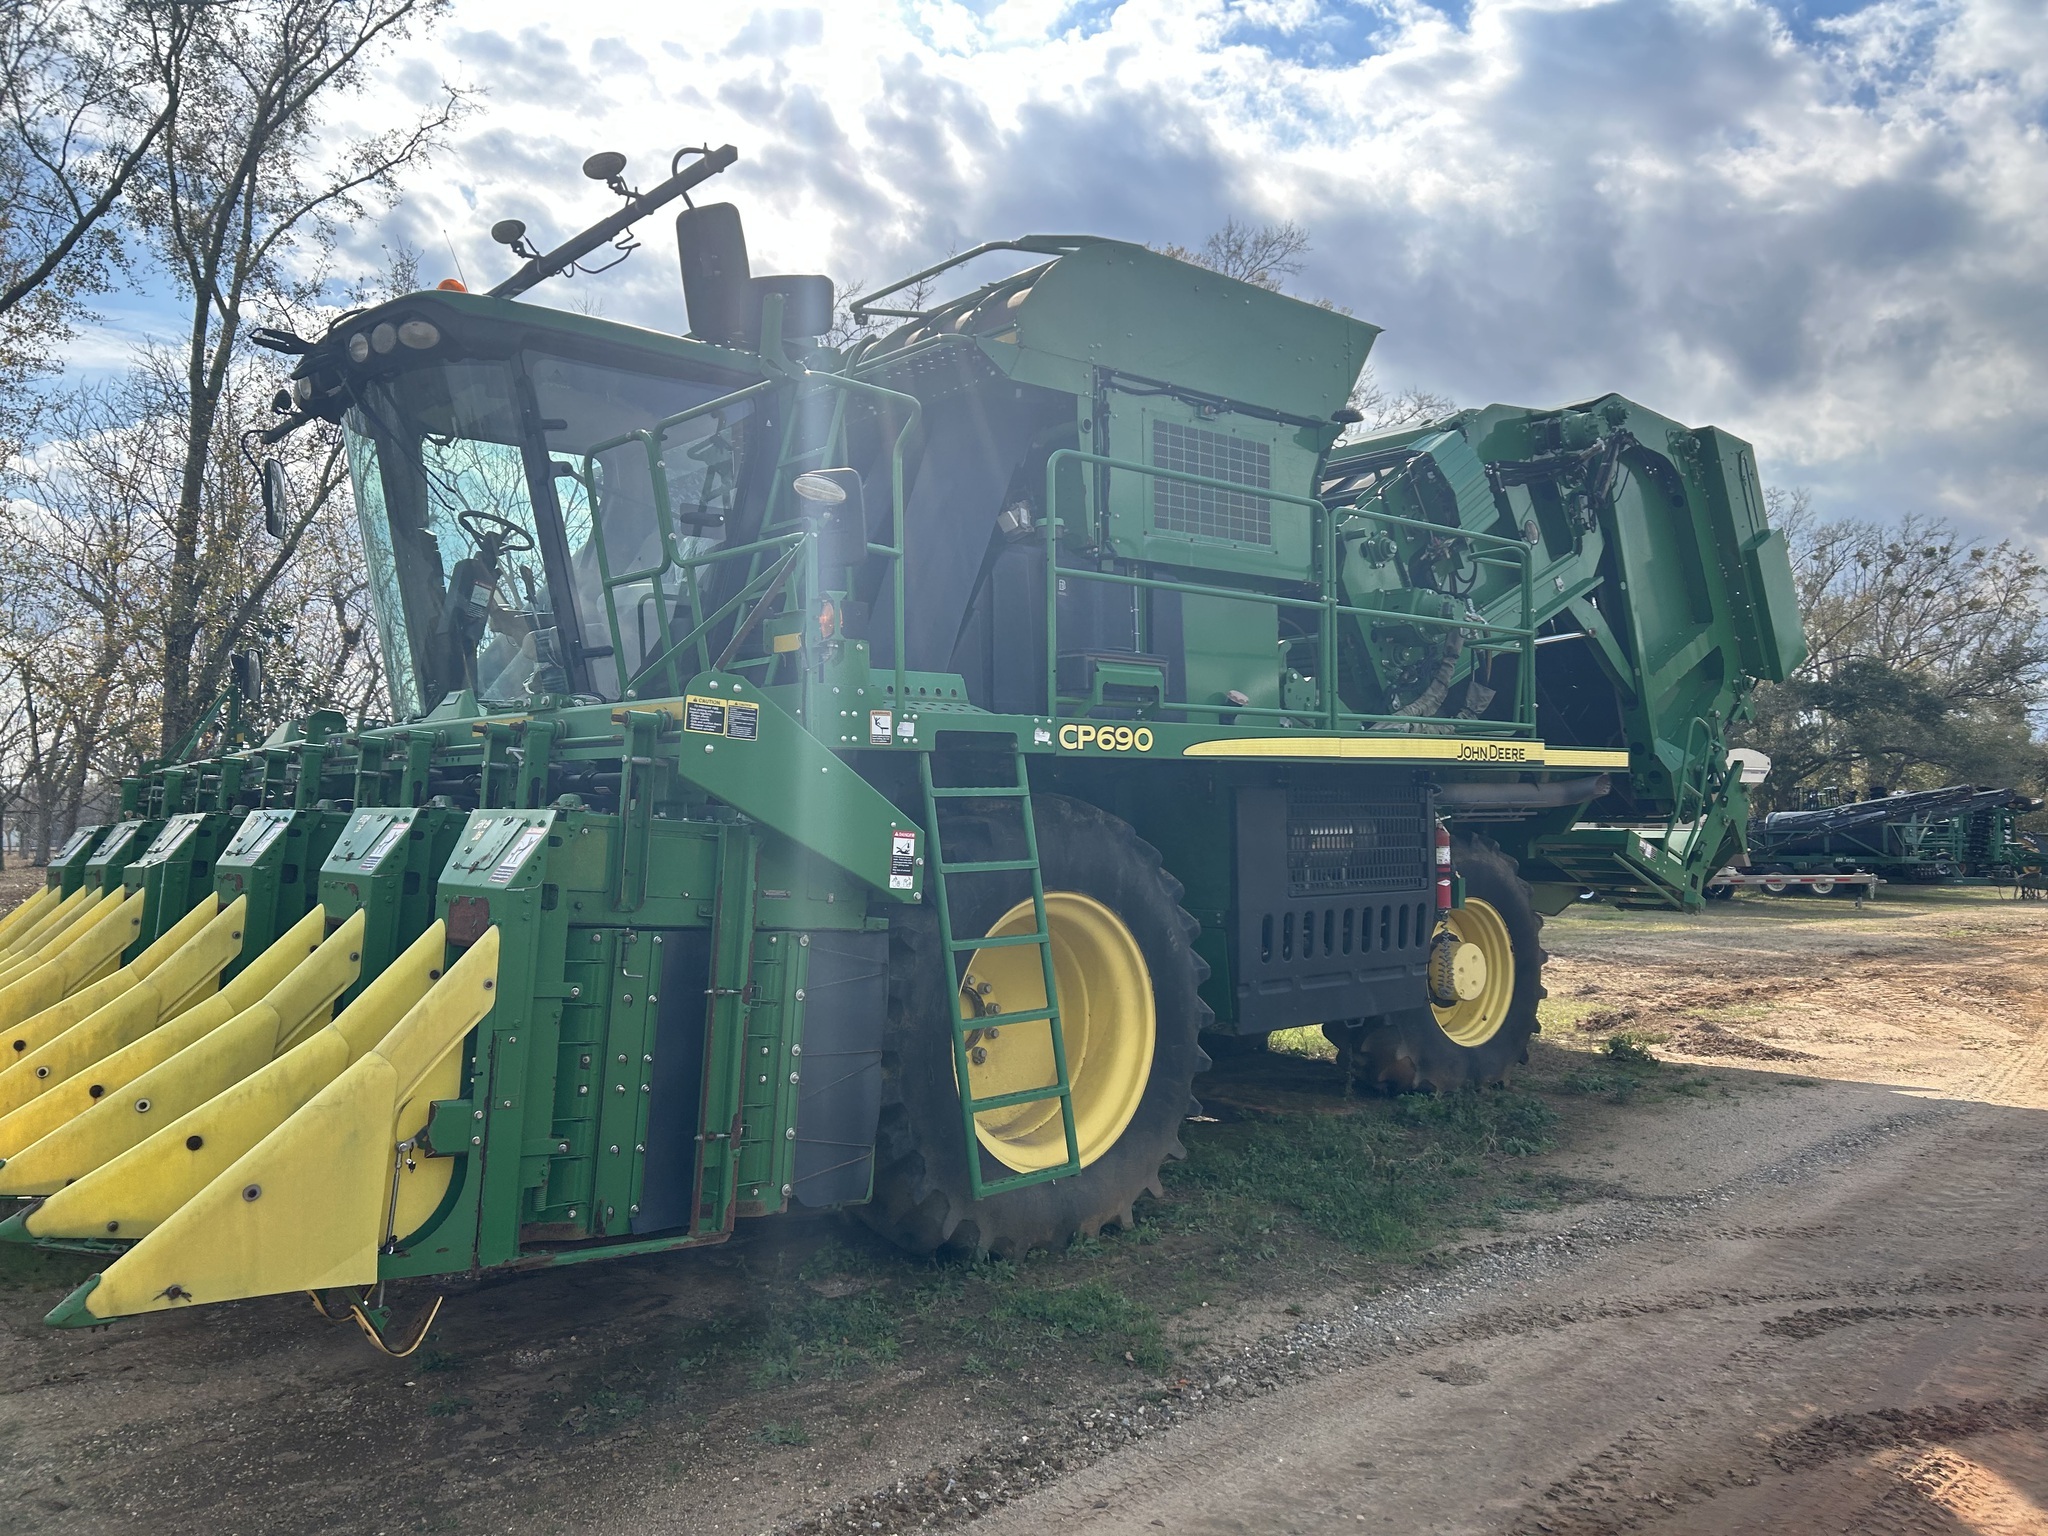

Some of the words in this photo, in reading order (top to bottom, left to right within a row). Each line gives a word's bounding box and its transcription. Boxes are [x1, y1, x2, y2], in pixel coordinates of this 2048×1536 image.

[698, 697, 720, 705] CAUTION
[1059, 724, 1154, 752] CP690
[1457, 743, 1488, 759] JOHN
[1489, 744, 1526, 760] DEERE
